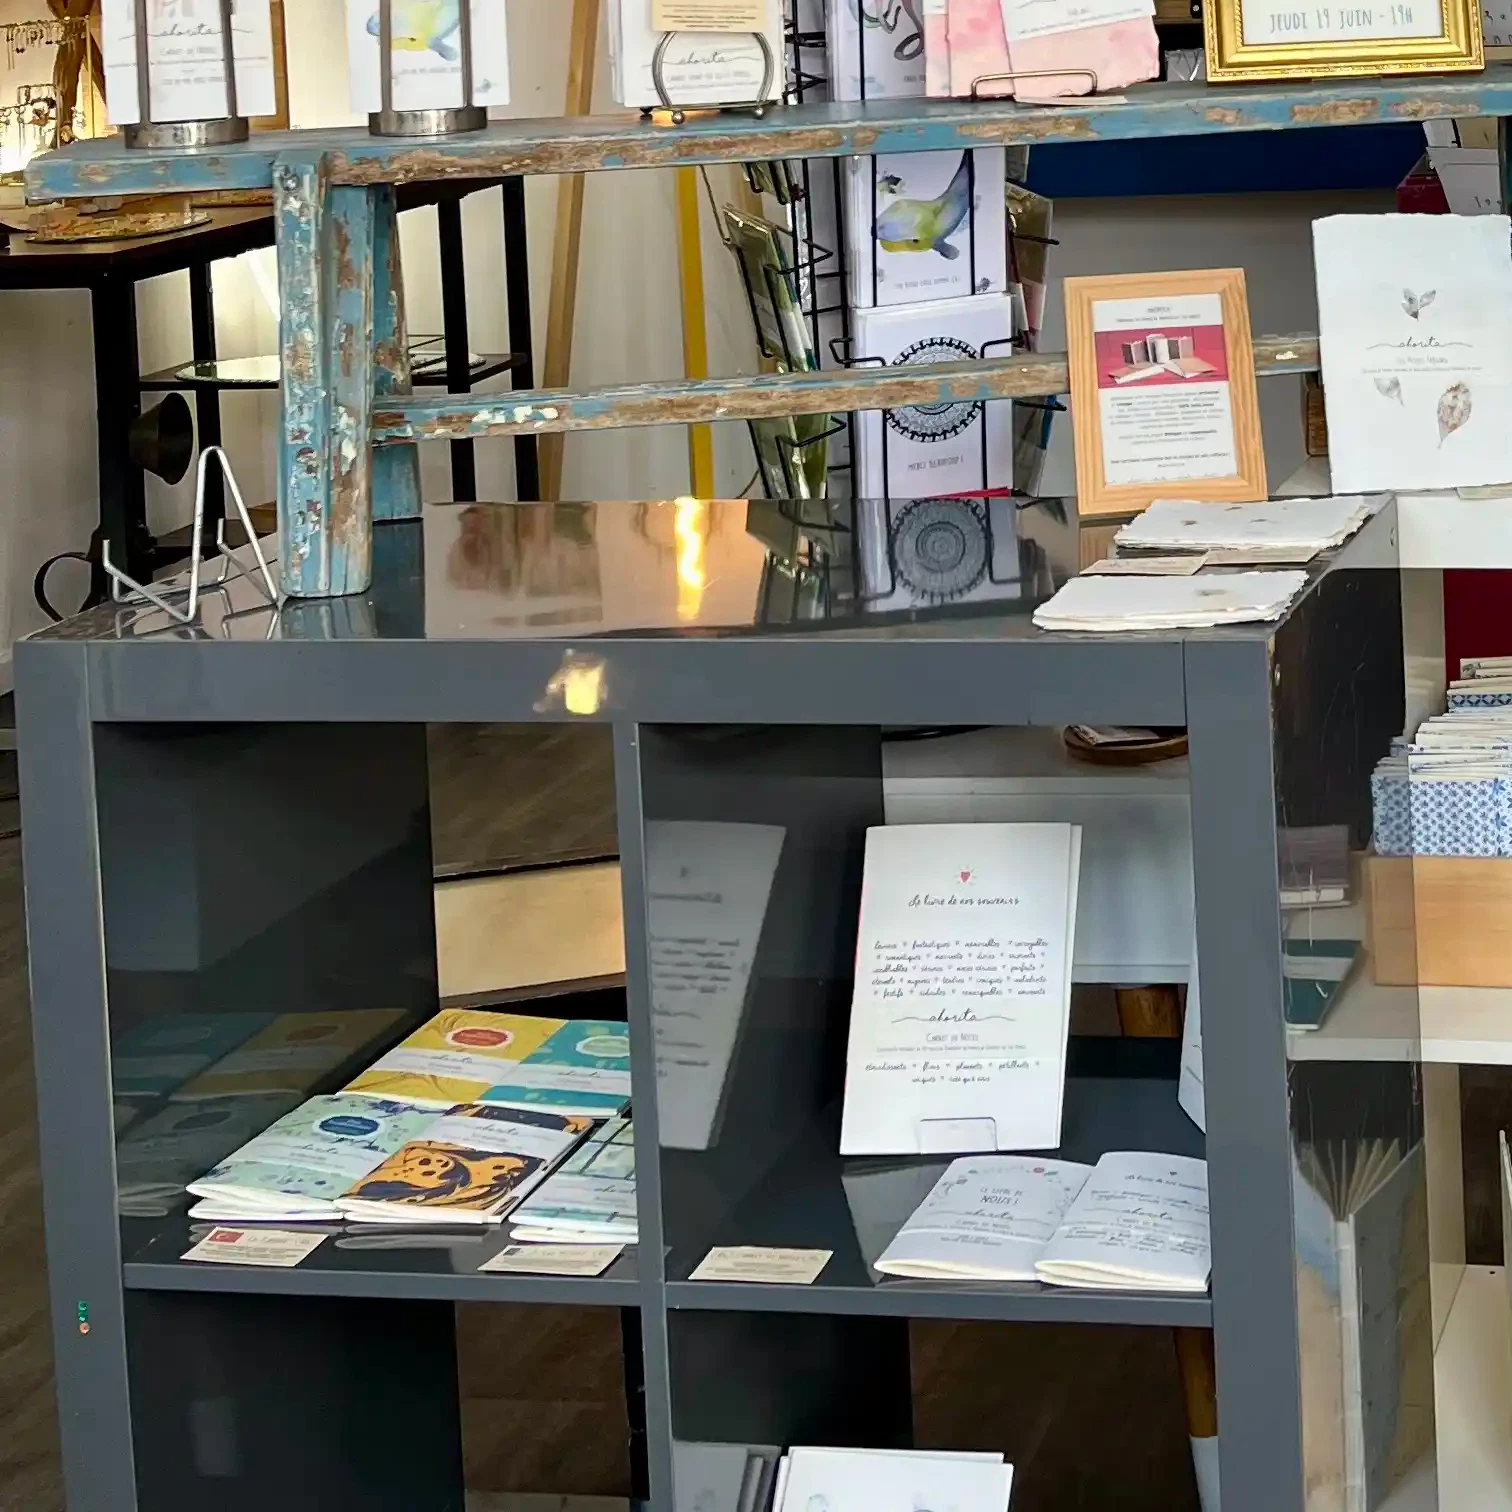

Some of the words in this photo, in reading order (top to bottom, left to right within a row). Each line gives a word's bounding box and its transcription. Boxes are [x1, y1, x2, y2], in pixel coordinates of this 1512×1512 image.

[1269, 12, 1308, 33] JEUDI
[1316, 8, 1330, 29] 19
[1339, 8, 1372, 29] JUIN
[1391, 4, 1413, 26] 19H
